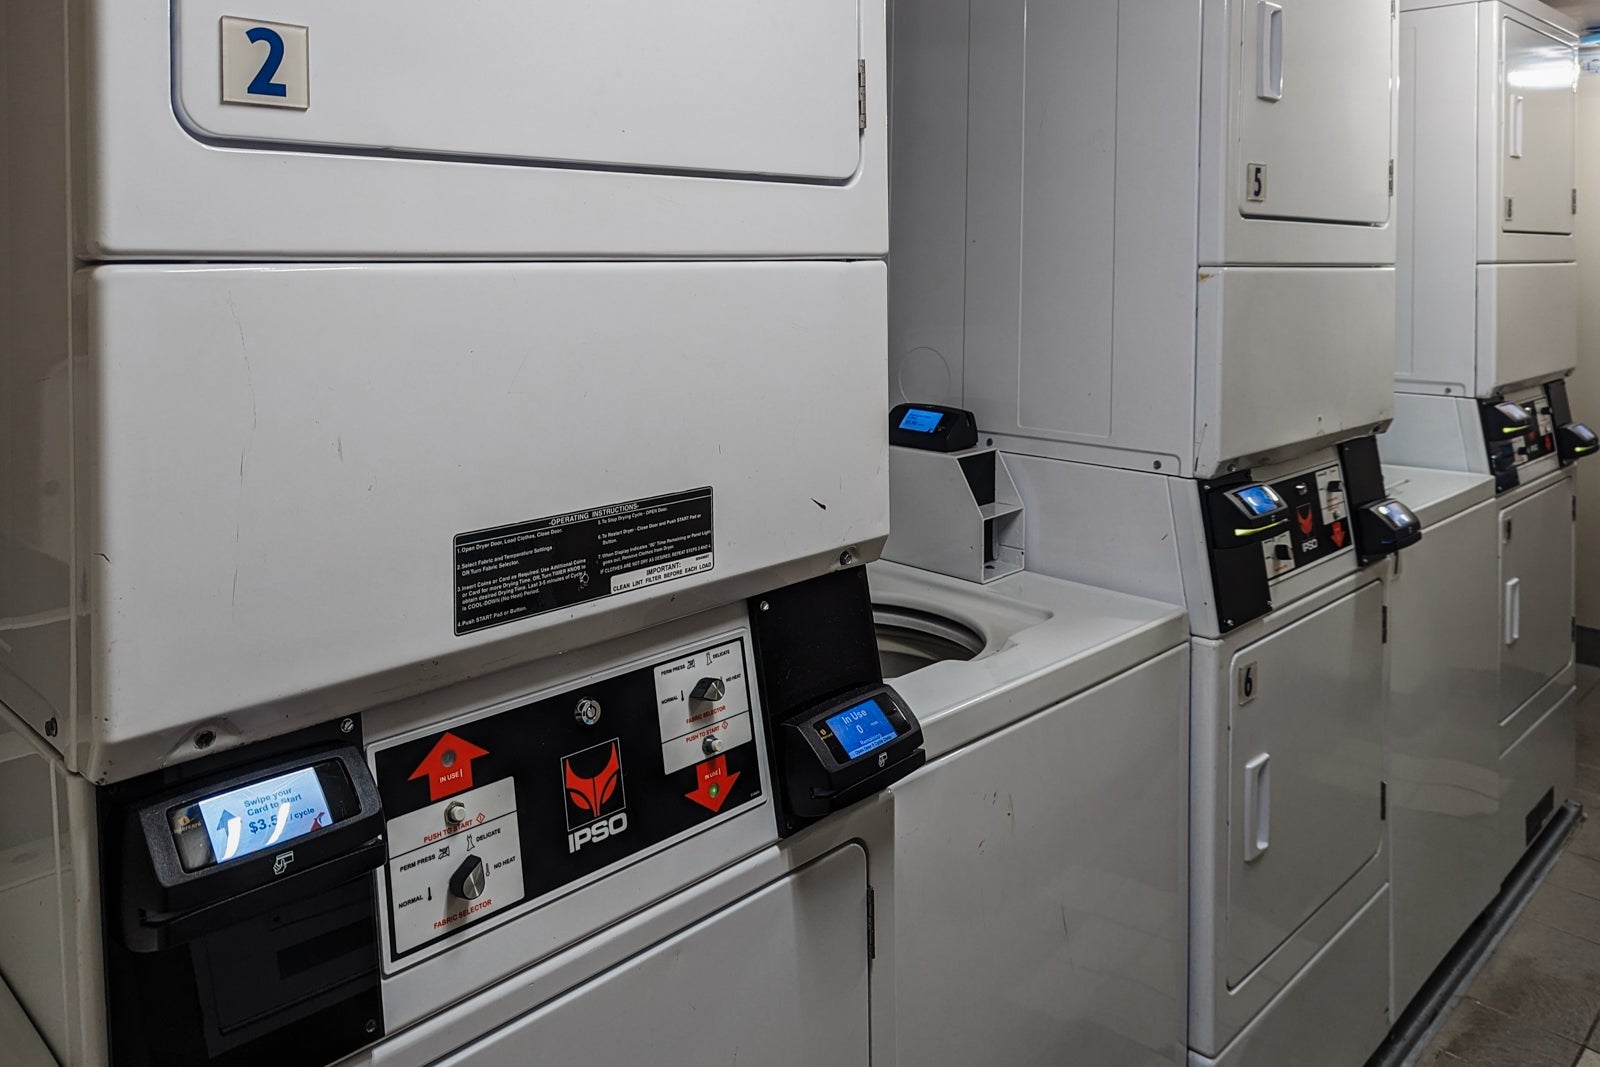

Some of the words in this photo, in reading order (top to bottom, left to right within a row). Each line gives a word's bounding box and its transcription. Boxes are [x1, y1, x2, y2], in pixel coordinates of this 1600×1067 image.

[245, 27, 287, 98] 2
[1254, 167, 1262, 197] 5
[477, 557, 493, 565] Fabric
[646, 561, 681, 575] IMPORTANT:
[612, 582, 630, 591] CLEAN
[645, 574, 661, 583] FILTER
[663, 569, 682, 578] BEFORE
[699, 561, 711, 569] LOAD
[475, 613, 492, 622] START
[713, 650, 730, 659] DELICATE
[1244, 667, 1253, 697] 6
[703, 705, 726, 717] SELECTOR
[842, 716, 852, 725] In
[851, 709, 868, 720] Use
[686, 735, 698, 743] PUSH
[706, 726, 720, 735] START
[447, 772, 459, 781] USE
[244, 795, 271, 807] Swipe
[273, 788, 292, 800] your
[247, 805, 269, 816] Card
[294, 808, 315, 819] cycle
[424, 832, 442, 843] PUSH
[443, 827, 452, 835] TO
[453, 820, 473, 832] START
[476, 828, 501, 842] DELICATE
[568, 812, 628, 854] IPSO
[400, 861, 416, 872] PERM
[417, 854, 436, 866] PRESS
[503, 856, 516, 866] HEAT
[399, 895, 423, 909] NORMAL
[434, 913, 457, 929] FABRIC
[459, 899, 492, 917] SELECTOR
